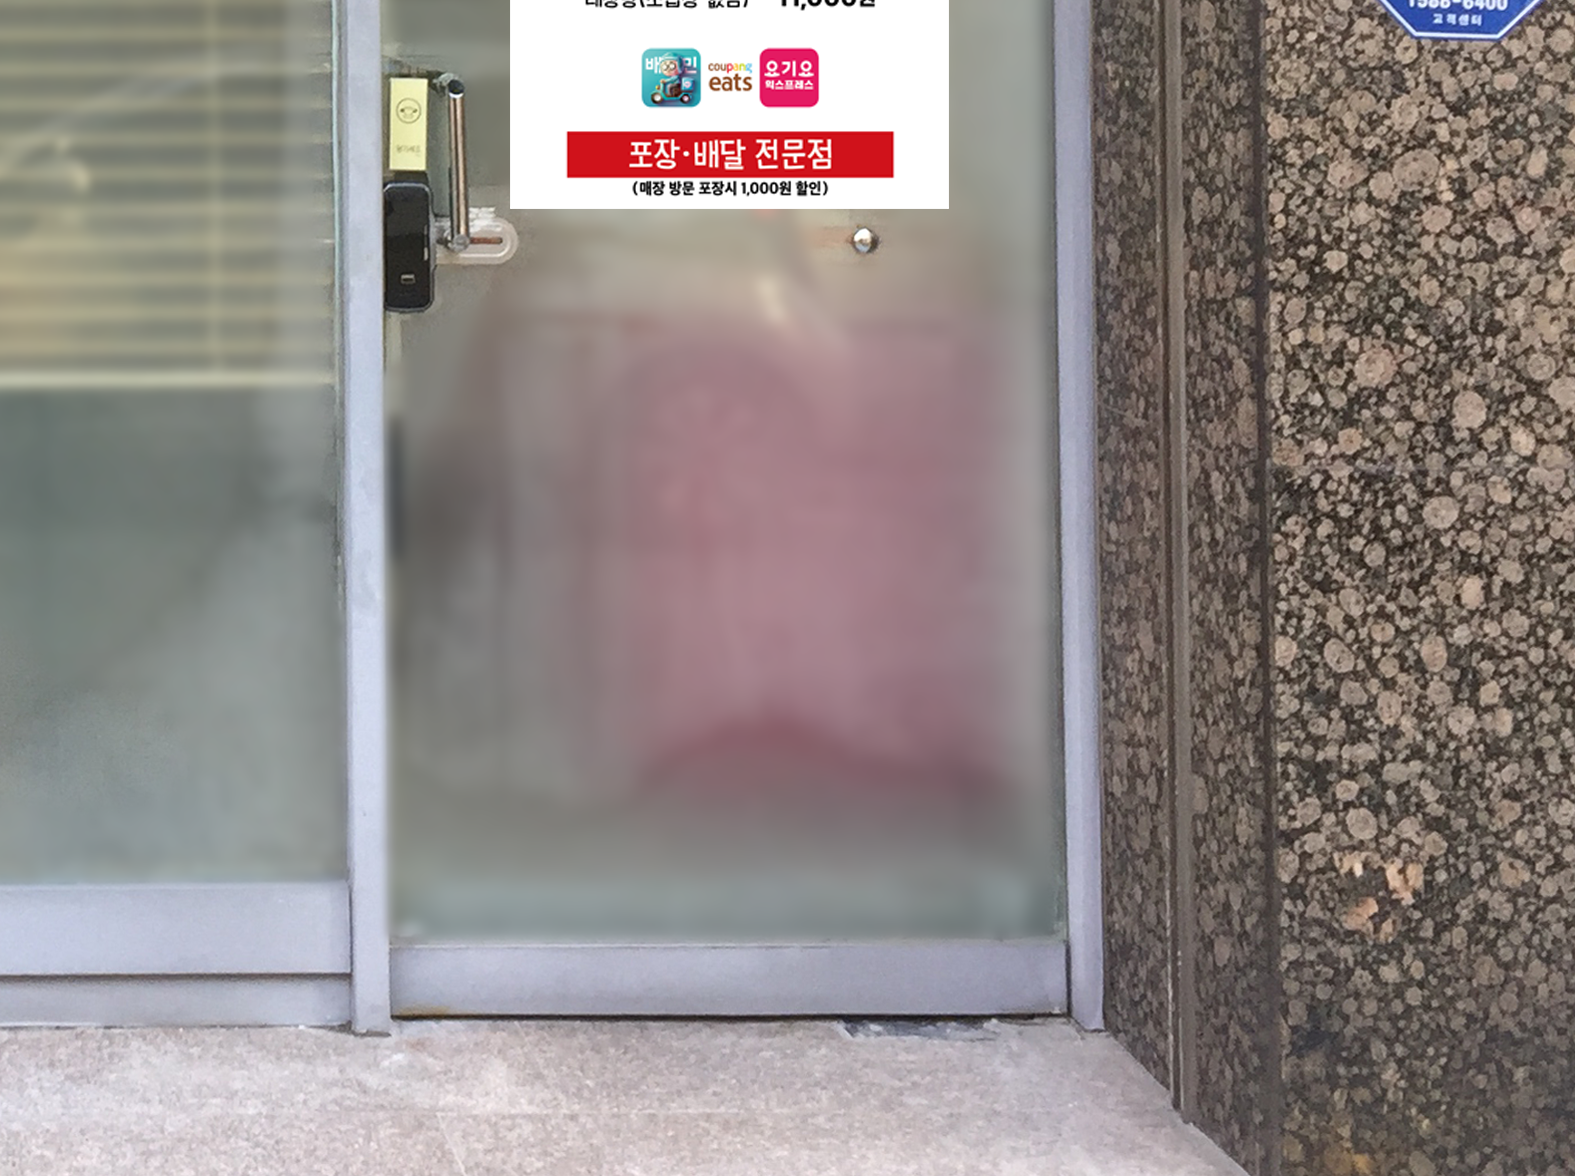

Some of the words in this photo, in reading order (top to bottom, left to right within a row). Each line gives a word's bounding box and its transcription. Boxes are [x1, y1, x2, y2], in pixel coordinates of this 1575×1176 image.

[708, 63, 752, 74] coupang
[764, 60, 814, 77] 요기요
[709, 73, 752, 91] eats
[765, 80, 813, 90] 익스프레스
[629, 139, 746, 169] 포장·배달
[756, 139, 831, 169] 전문점
[632, 181, 665, 196] (매장
[669, 181, 694, 196] 방문
[699, 181, 737, 196] 포장시
[741, 181, 791, 196] 1,000원
[796, 181, 829, 196] 할인)
